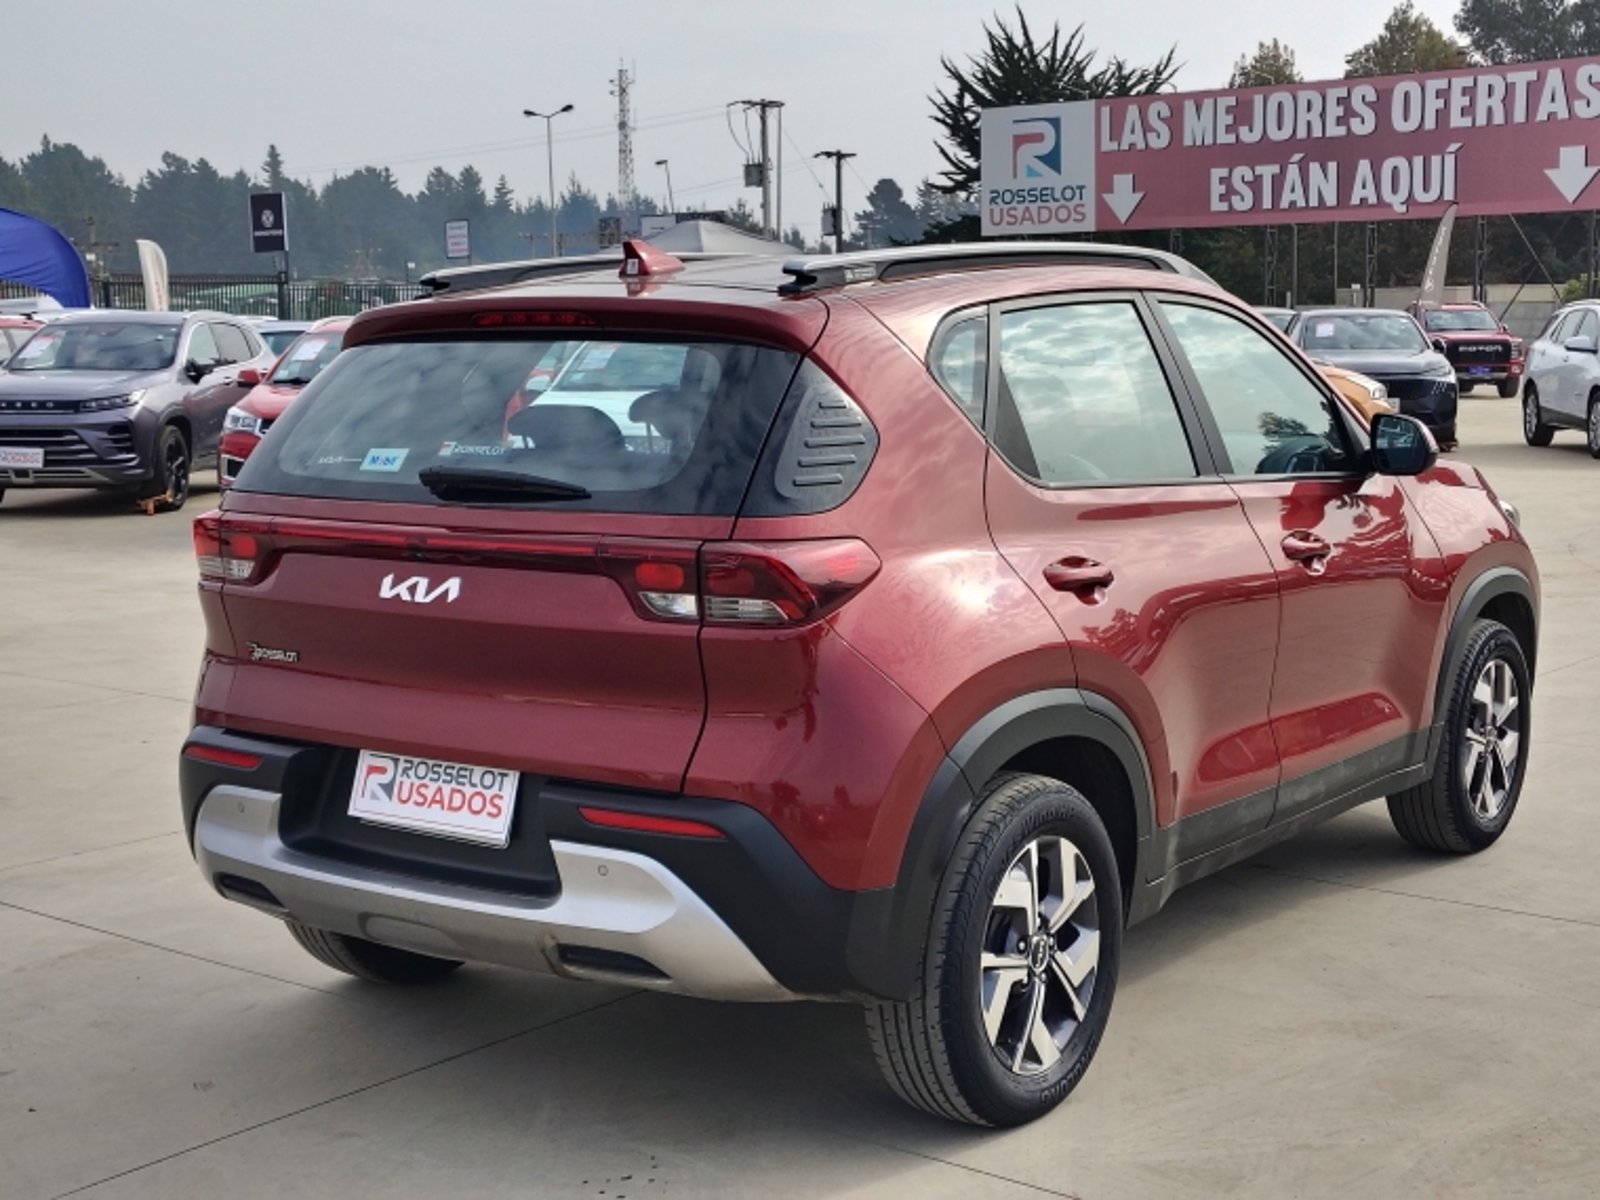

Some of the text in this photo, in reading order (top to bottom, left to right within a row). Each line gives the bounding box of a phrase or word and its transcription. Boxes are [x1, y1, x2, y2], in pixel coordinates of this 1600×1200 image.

[1100, 63, 1600, 152] LAS MEJORES OFERTAS
[988, 184, 1086, 206] ROSSELOT
[1210, 142, 1463, 213] ESTÁN AQUÍ
[988, 203, 1086, 226] USADOS
[399, 759, 509, 792] ROSSELOT
[397, 780, 504, 818] USADOS
